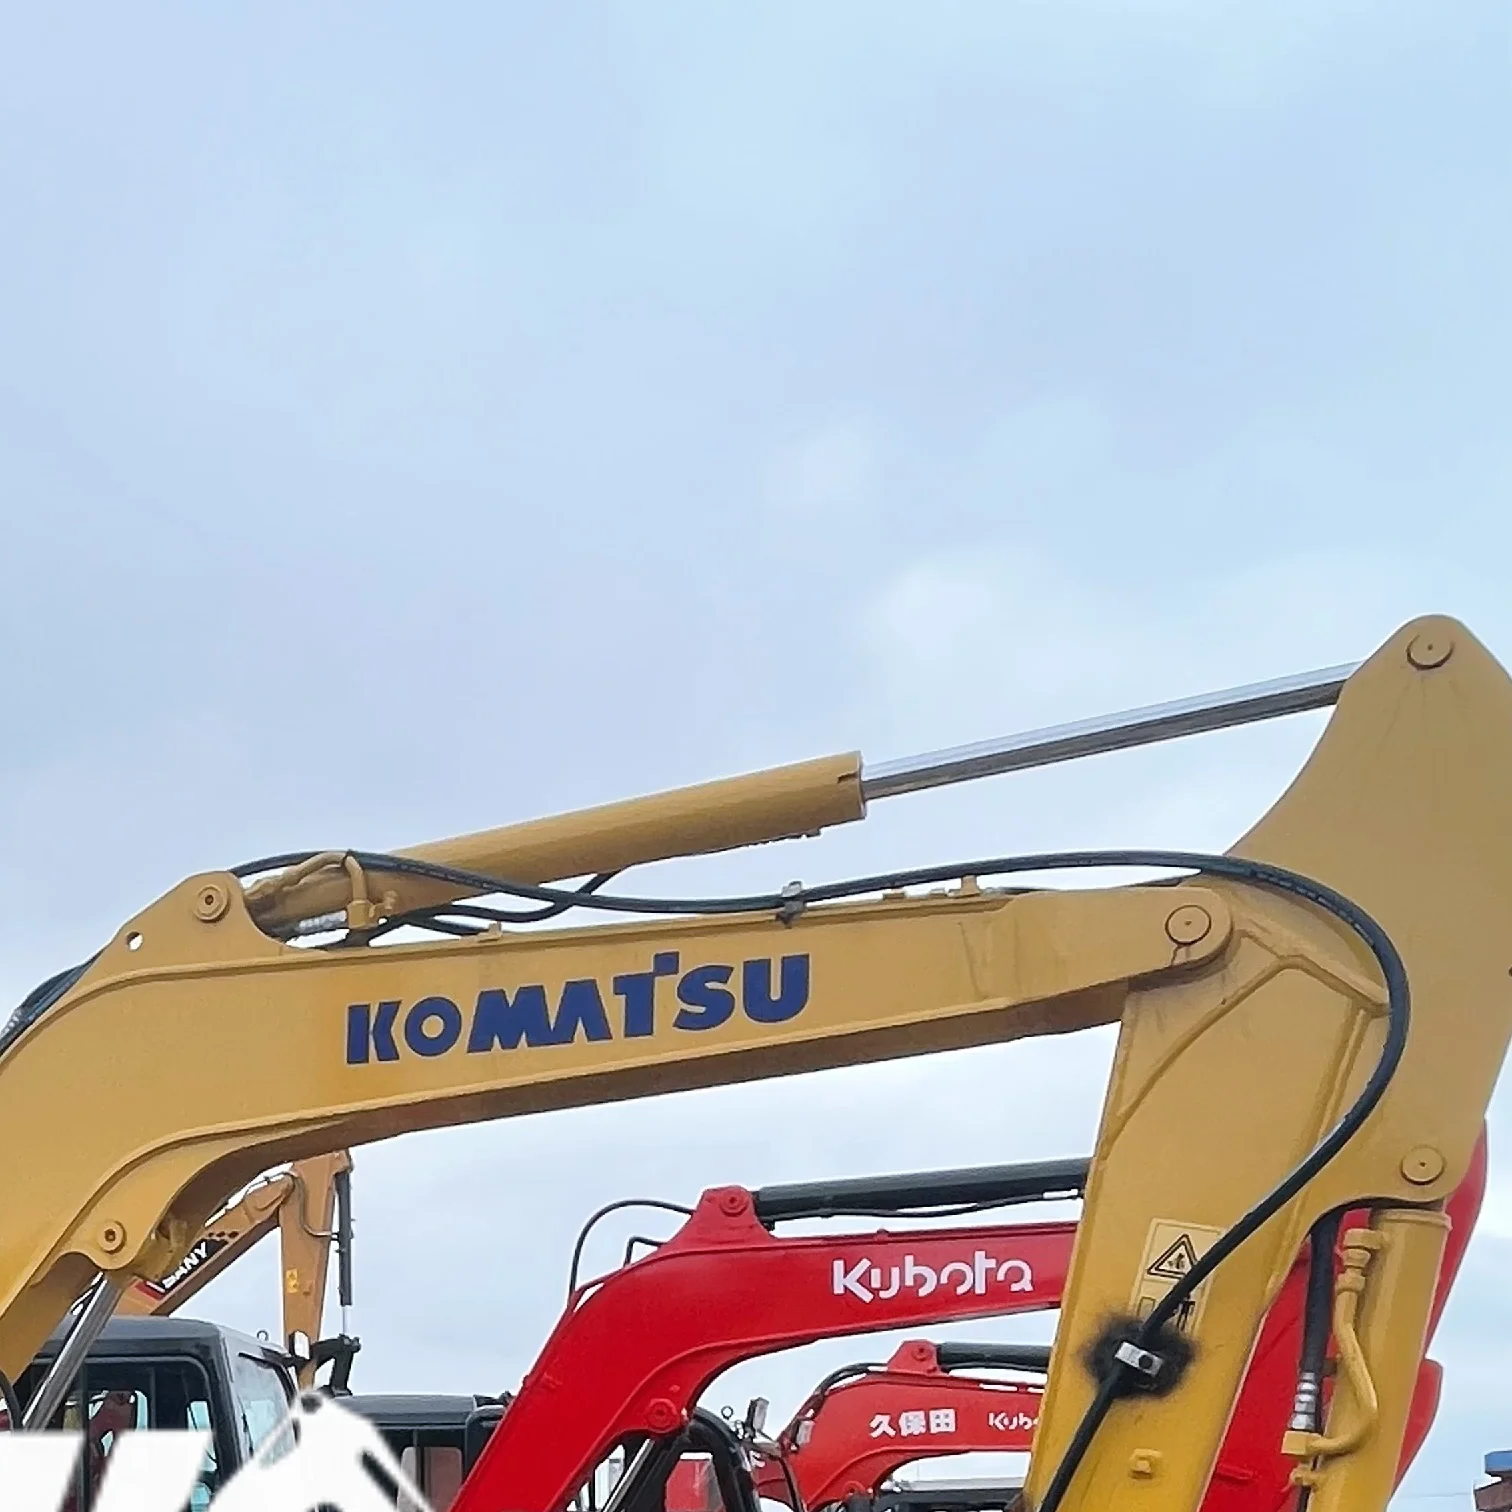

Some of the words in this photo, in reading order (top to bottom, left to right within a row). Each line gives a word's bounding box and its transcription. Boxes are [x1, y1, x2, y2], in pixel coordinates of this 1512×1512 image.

[345, 950, 810, 1065] KOMATSU
[833, 1250, 1034, 1303] Kubota
[869, 1408, 957, 1438] 久保田
[988, 1412, 1039, 1431] Kub
